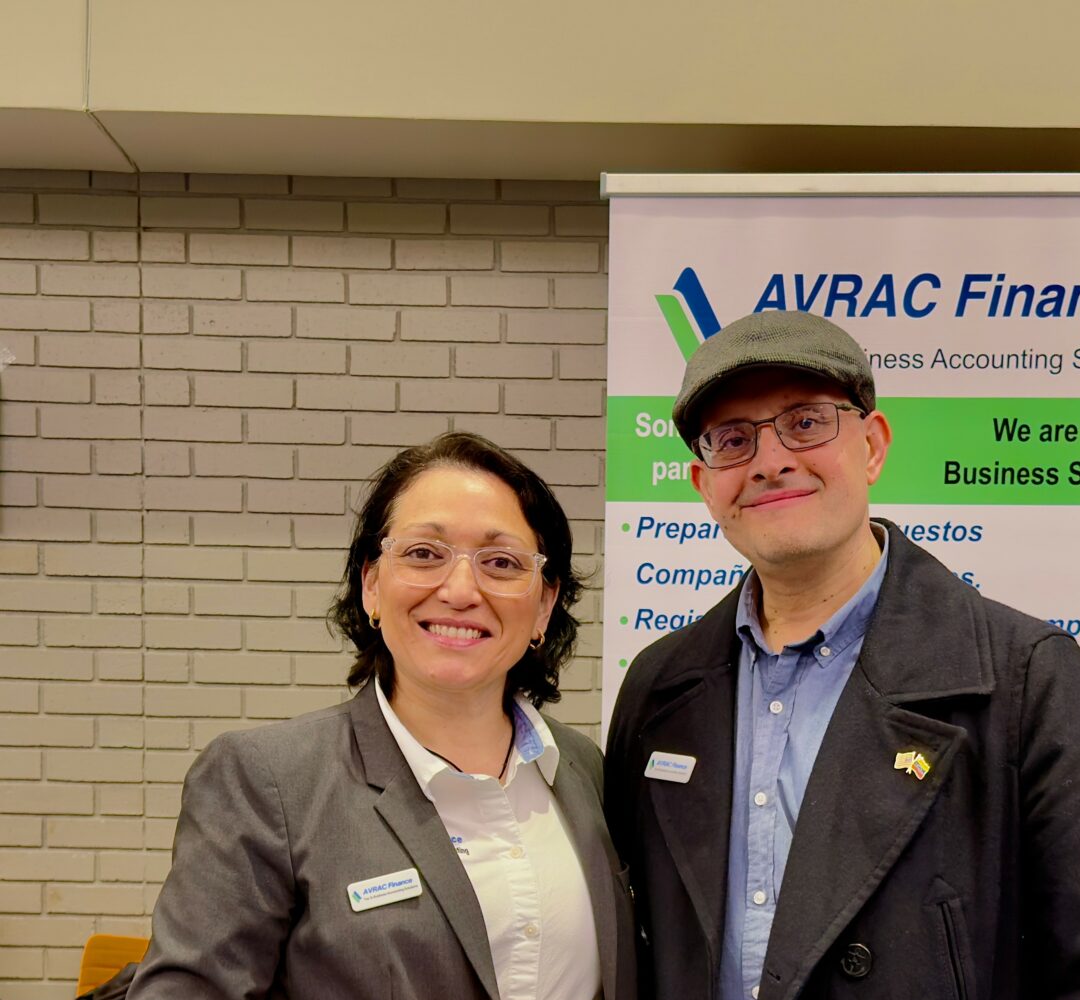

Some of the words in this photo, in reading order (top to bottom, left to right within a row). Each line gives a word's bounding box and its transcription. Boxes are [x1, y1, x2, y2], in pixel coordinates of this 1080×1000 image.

[753, 273, 941, 318] AVRAC
[930, 348, 1063, 375] Accounting
[993, 418, 1031, 442] We
[1039, 423, 1078, 442] are
[944, 461, 1059, 485] Business
[363, 883, 387, 895] AVRAC
[388, 879, 412, 888] Finance
